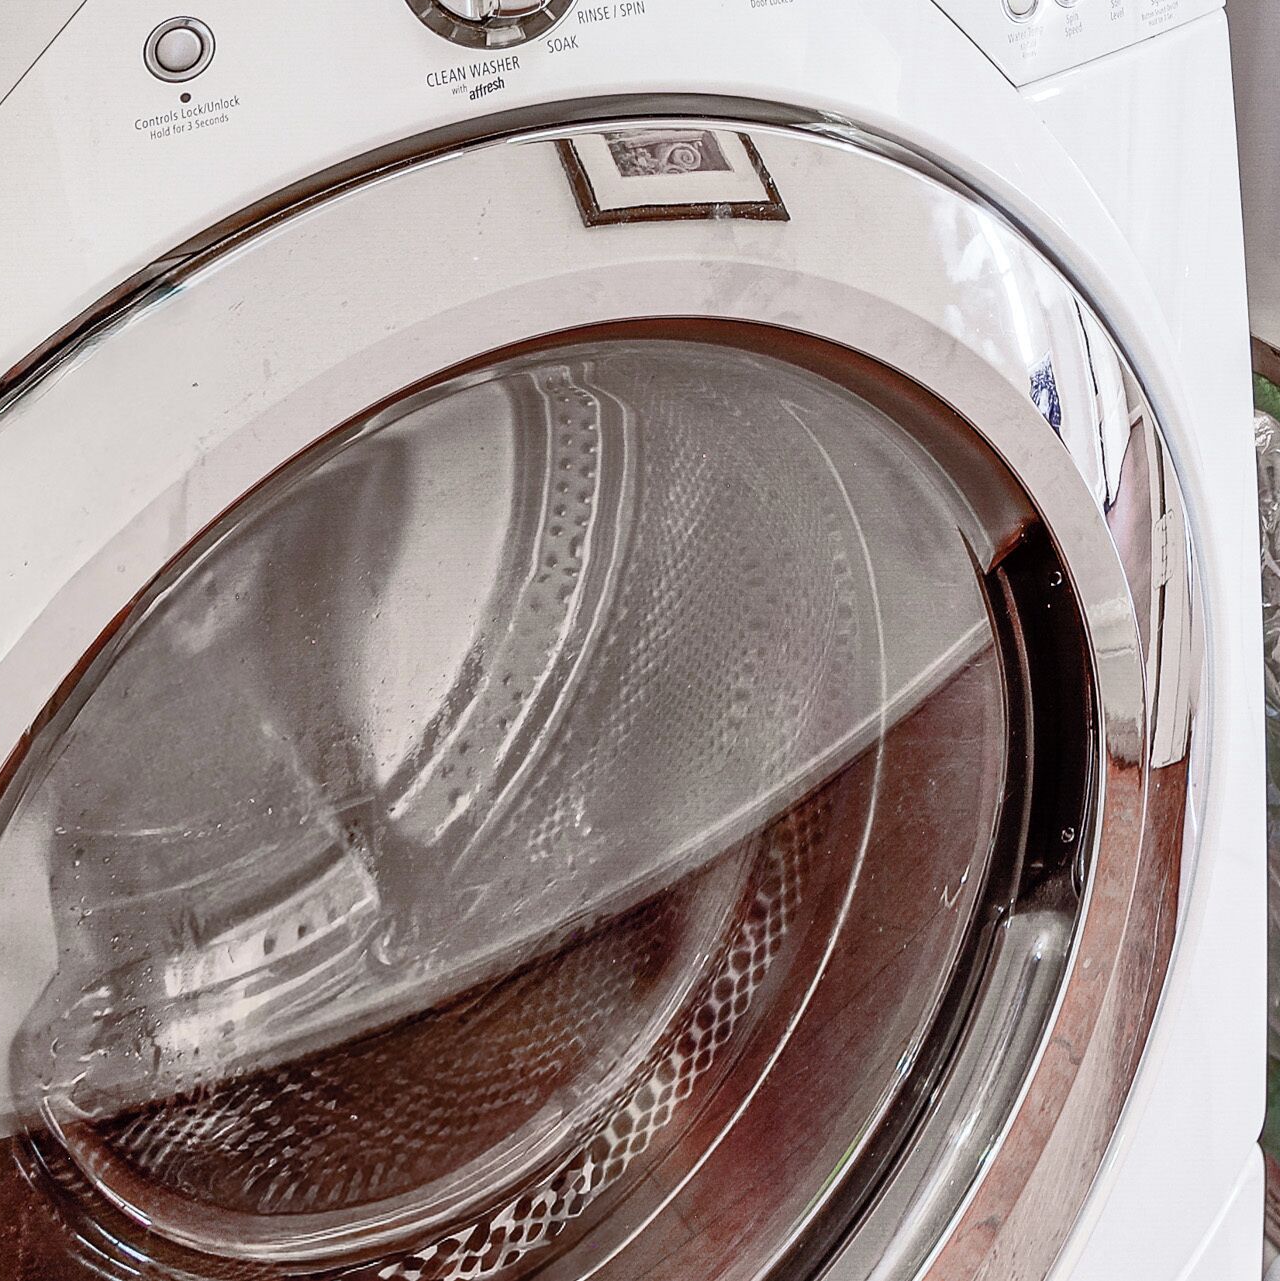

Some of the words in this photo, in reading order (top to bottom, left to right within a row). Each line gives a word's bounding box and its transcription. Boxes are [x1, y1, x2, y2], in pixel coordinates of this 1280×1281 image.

[578, 6, 610, 24] RINSE
[619, 1, 645, 17] SPIN
[547, 35, 579, 53] SOAK
[426, 66, 467, 87] CLEAN
[468, 56, 520, 78] WASHER
[452, 84, 468, 96] with
[469, 76, 505, 101] affresh
[134, 110, 178, 131] Controls
[181, 95, 241, 119] Lock/Unlock
[150, 127, 171, 140] Hold
[173, 124, 185, 134] for
[187, 122, 193, 131] 3
[195, 113, 229, 129] Seconds
